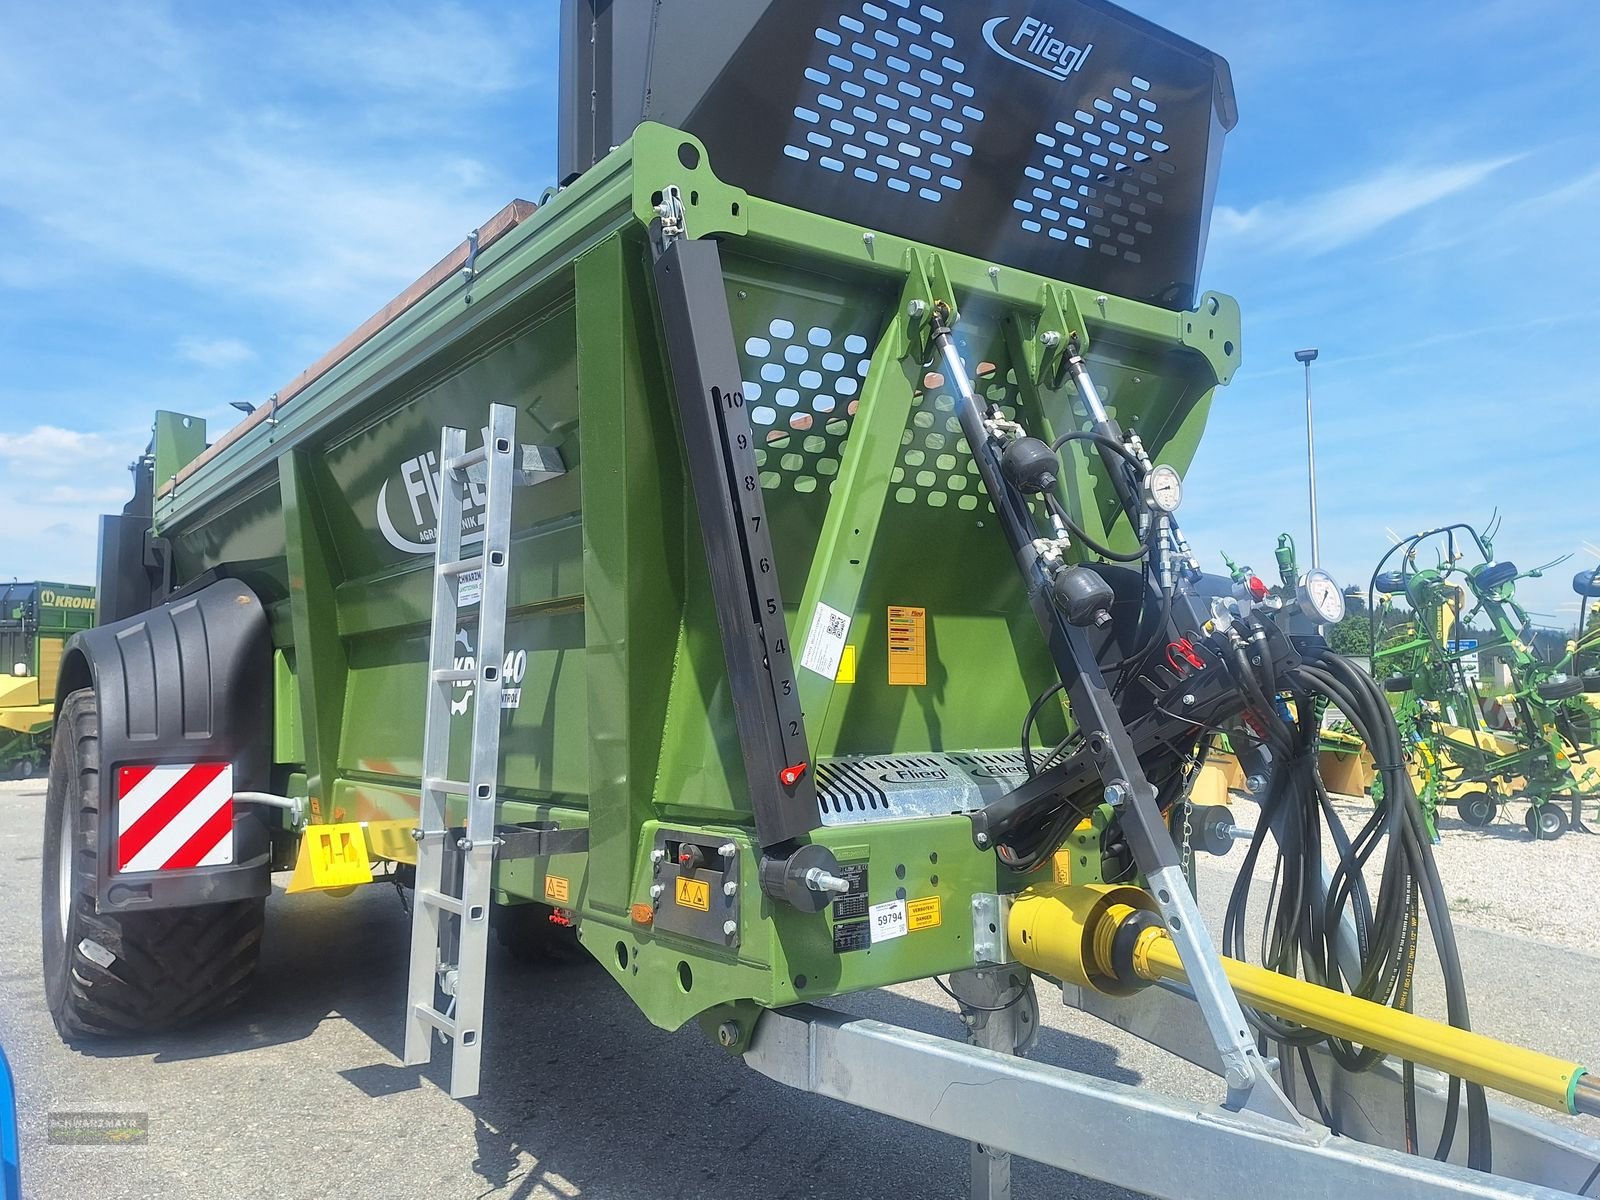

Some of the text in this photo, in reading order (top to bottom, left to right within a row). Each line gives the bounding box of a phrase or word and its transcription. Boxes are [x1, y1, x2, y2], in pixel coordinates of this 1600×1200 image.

[1011, 16, 1093, 76] Fliegl
[723, 392, 743, 409] 10
[737, 434, 747, 449] 9
[745, 475, 755, 491] 8
[752, 516, 761, 533] 7
[760, 558, 770, 573] 6
[766, 598, 776, 615] 5
[775, 639, 785, 654] 4
[453, 656, 478, 688] KD
[782, 679, 791, 696] 3
[789, 720, 799, 737] 2
[896, 768, 948, 780] Fliegl
[984, 764, 1028, 775] Flieg
[877, 911, 903, 926] 59794
